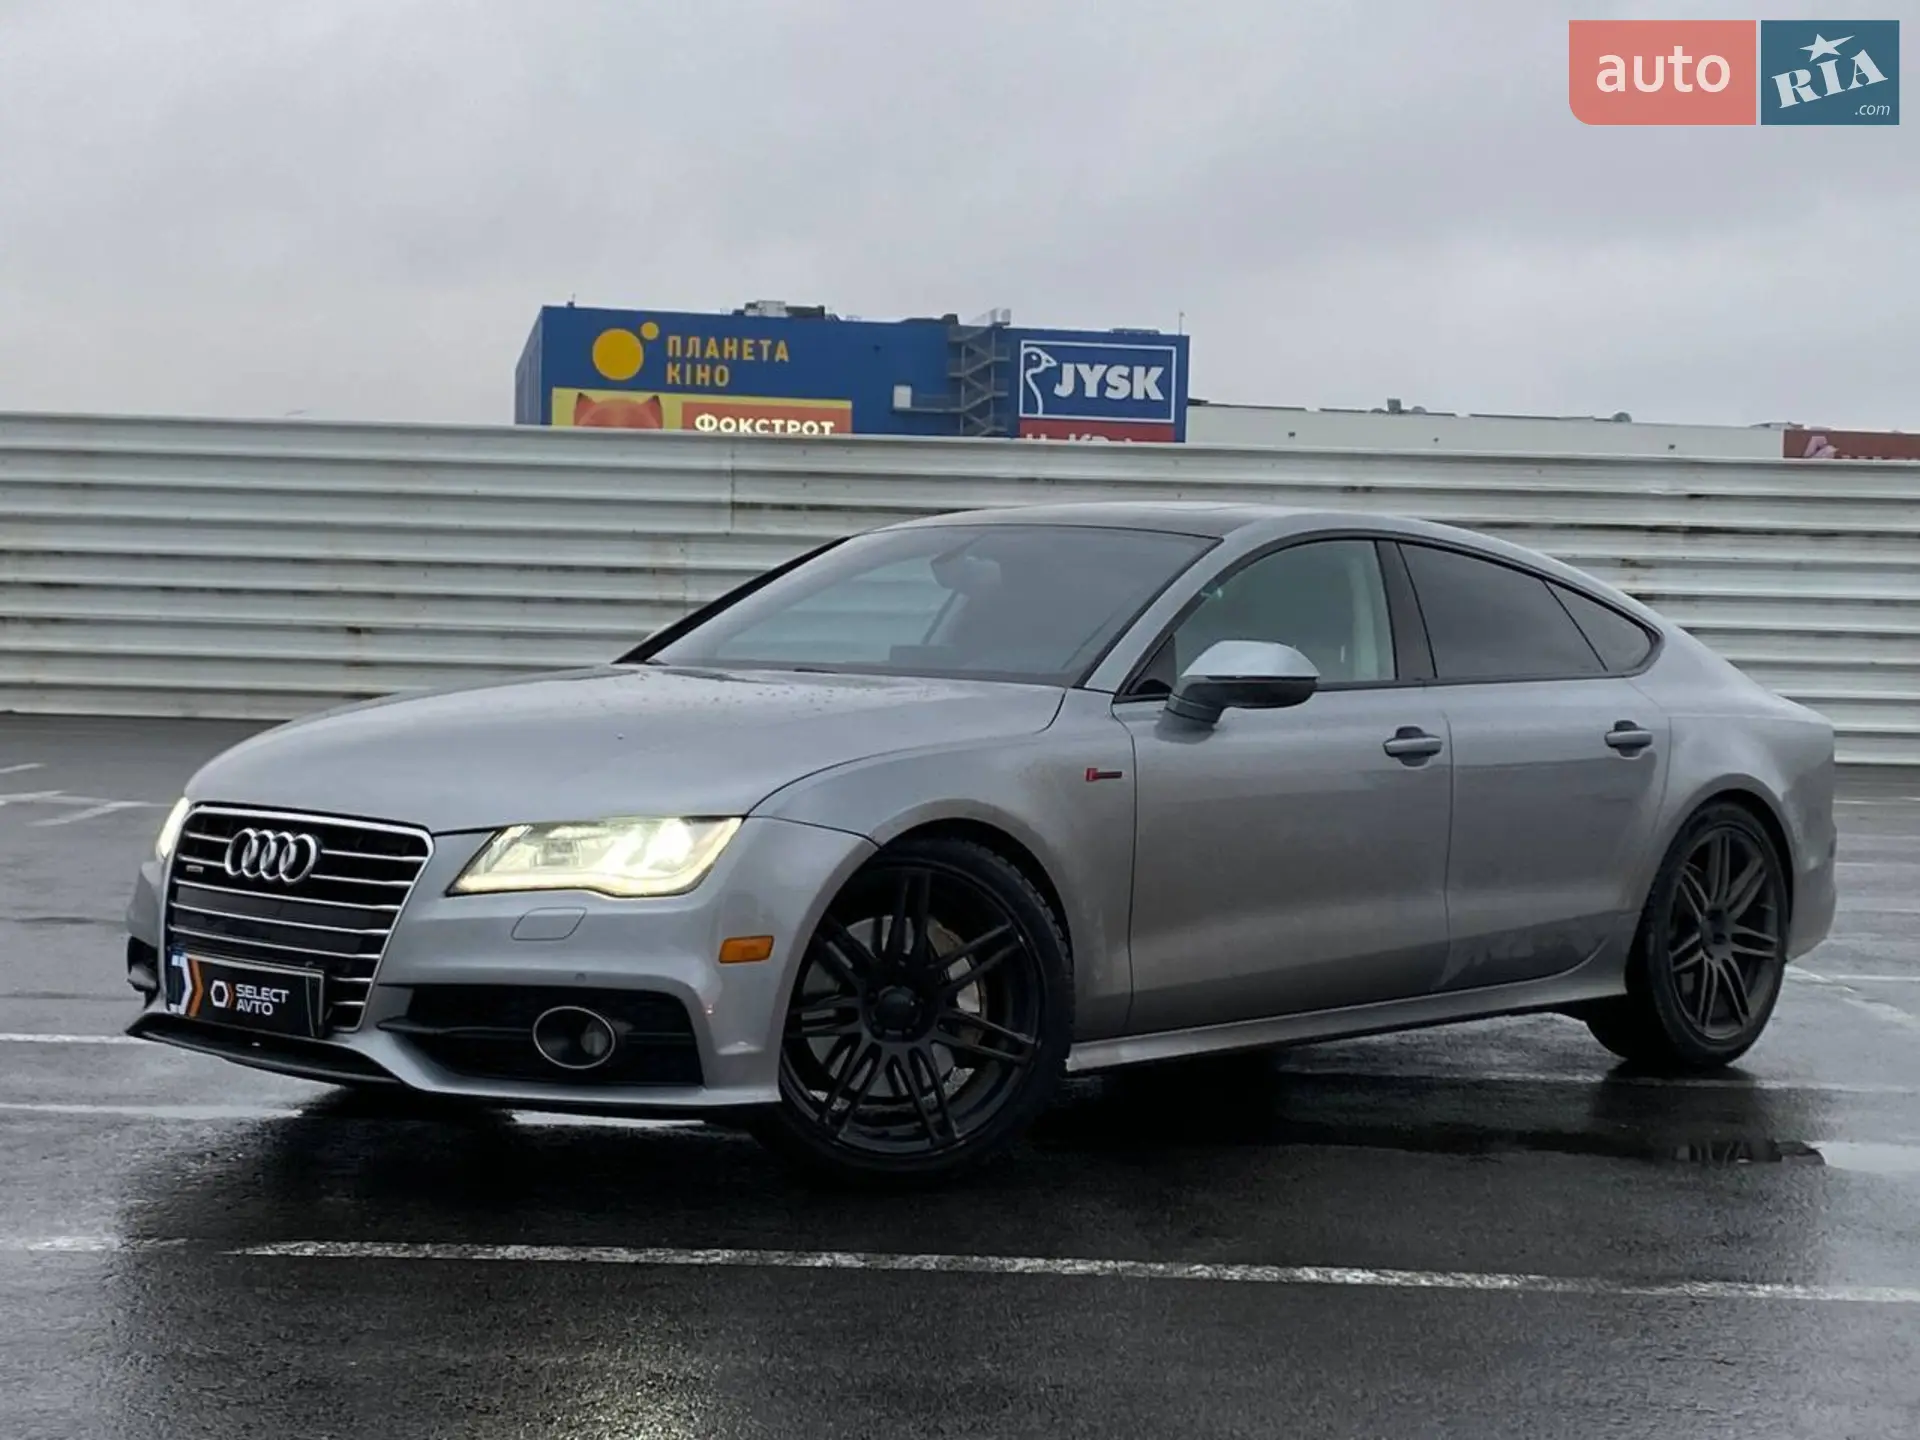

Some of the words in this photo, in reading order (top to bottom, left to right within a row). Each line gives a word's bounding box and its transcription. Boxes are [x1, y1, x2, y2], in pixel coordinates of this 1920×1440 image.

[667, 335, 790, 363] ПЛАНЕТА
[667, 363, 730, 387] КІНО
[1053, 362, 1165, 400] JYSK
[694, 412, 836, 435] ФОКСТРОТ
[235, 983, 290, 1003] SELECT
[236, 1001, 274, 1016] AVTO
